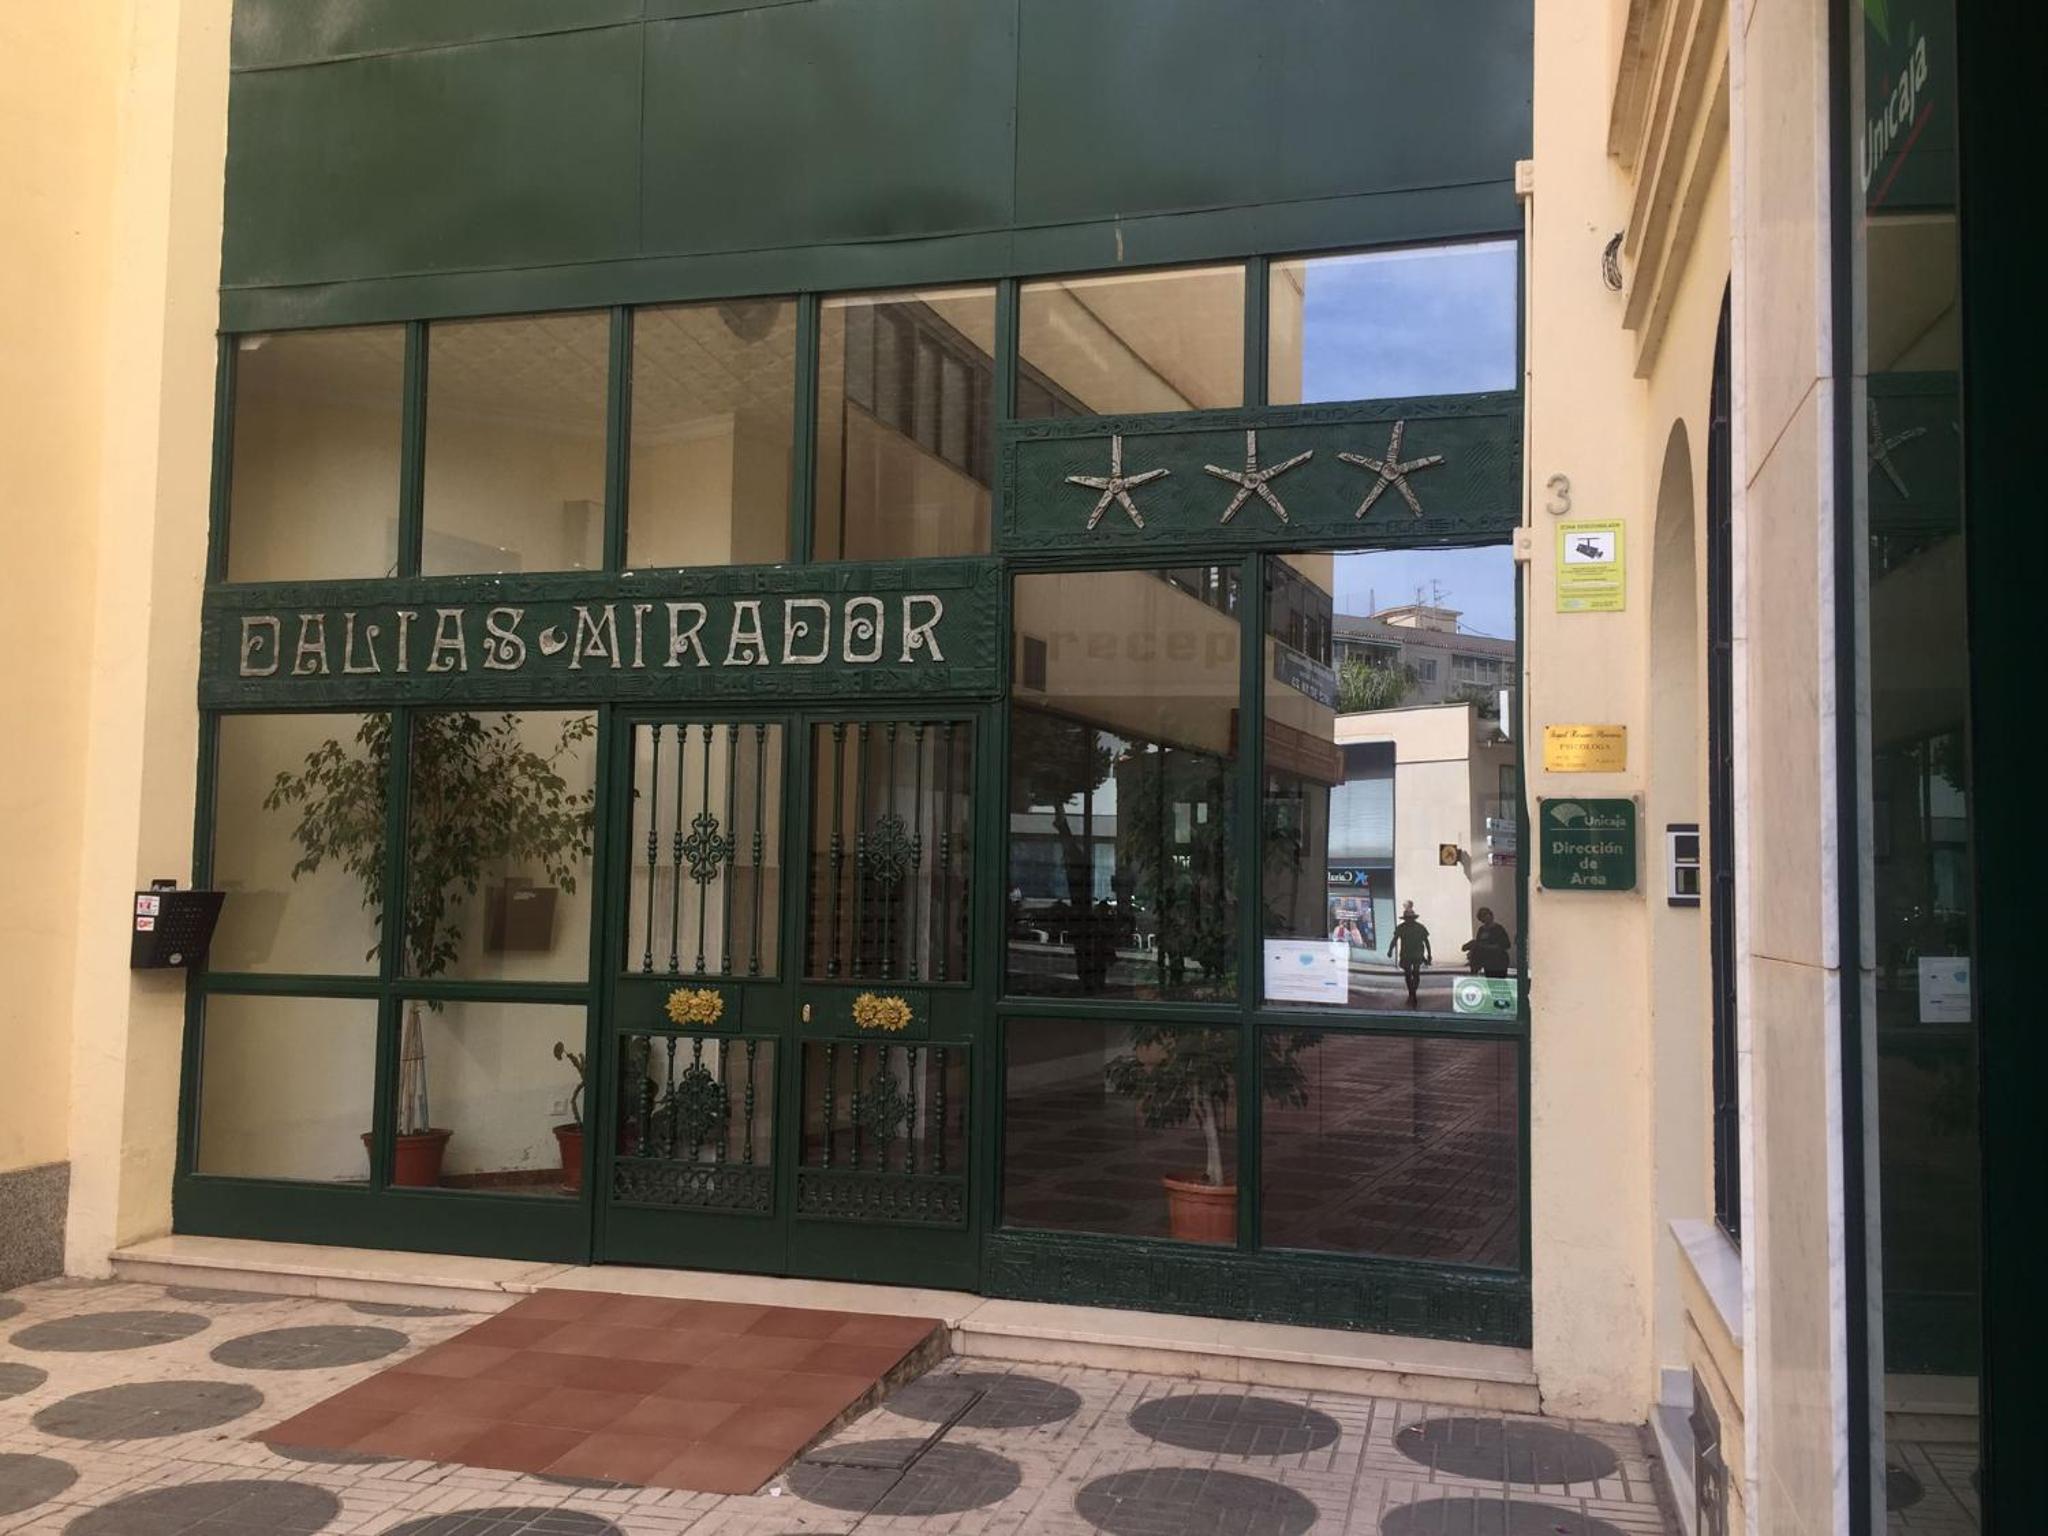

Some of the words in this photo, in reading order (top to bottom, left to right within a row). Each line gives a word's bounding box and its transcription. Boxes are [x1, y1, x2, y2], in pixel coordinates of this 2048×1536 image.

[1860, 36, 1928, 193] Unicaja
[1546, 473, 1572, 516] 3
[239, 606, 527, 677] DALIAS
[567, 594, 945, 670] MIRADOR
[1584, 814, 1627, 828] Unicaja
[1552, 841, 1624, 855] Dirección
[1579, 856, 1598, 870] de
